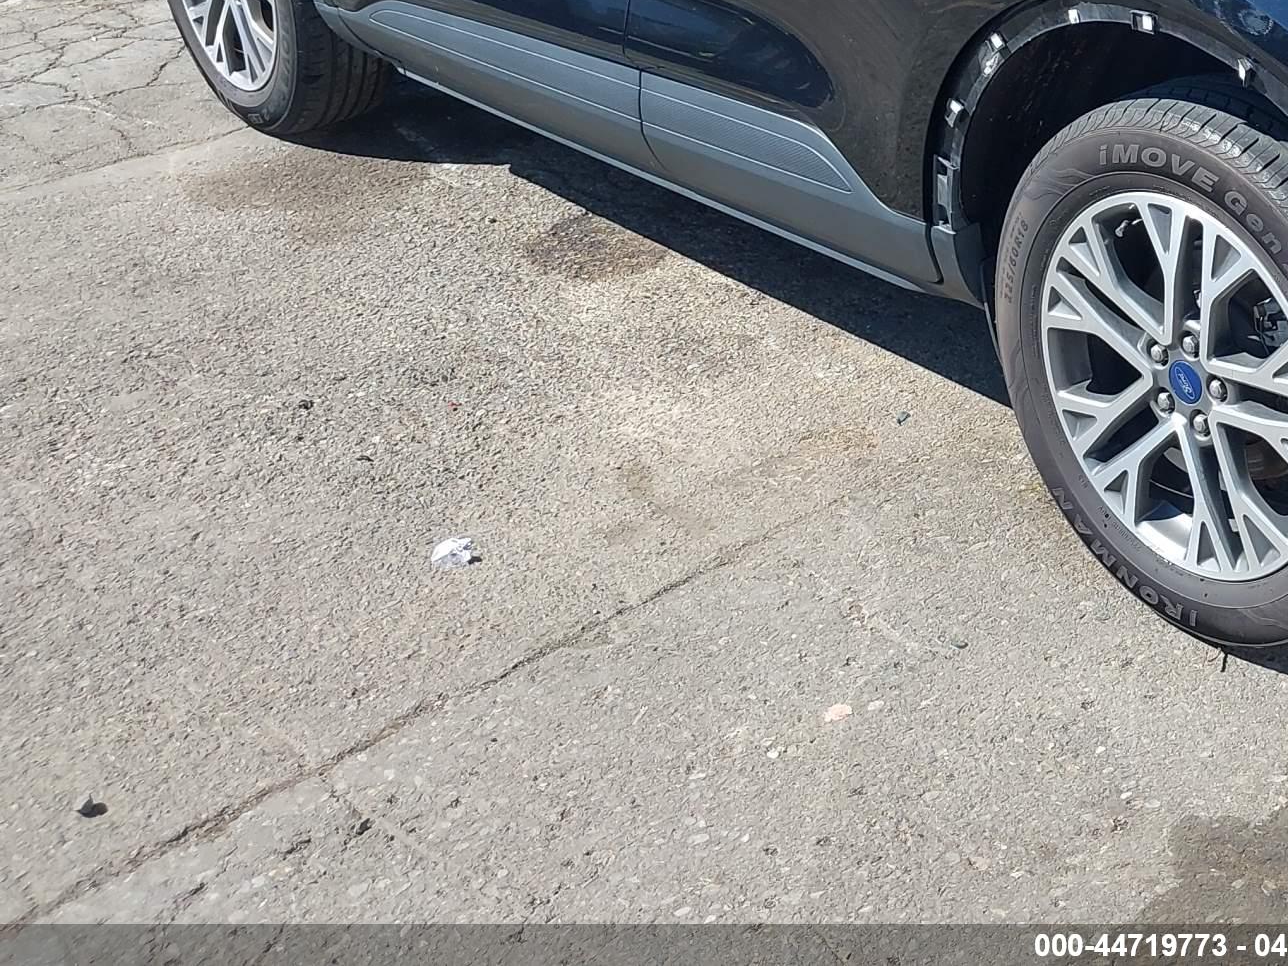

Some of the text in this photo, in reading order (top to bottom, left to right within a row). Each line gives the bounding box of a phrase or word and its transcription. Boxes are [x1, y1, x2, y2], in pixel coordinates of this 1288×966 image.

[1099, 143, 1220, 193] iMOVE
[1224, 190, 1282, 255] Gen
[1050, 487, 1199, 626] IRONMAN
